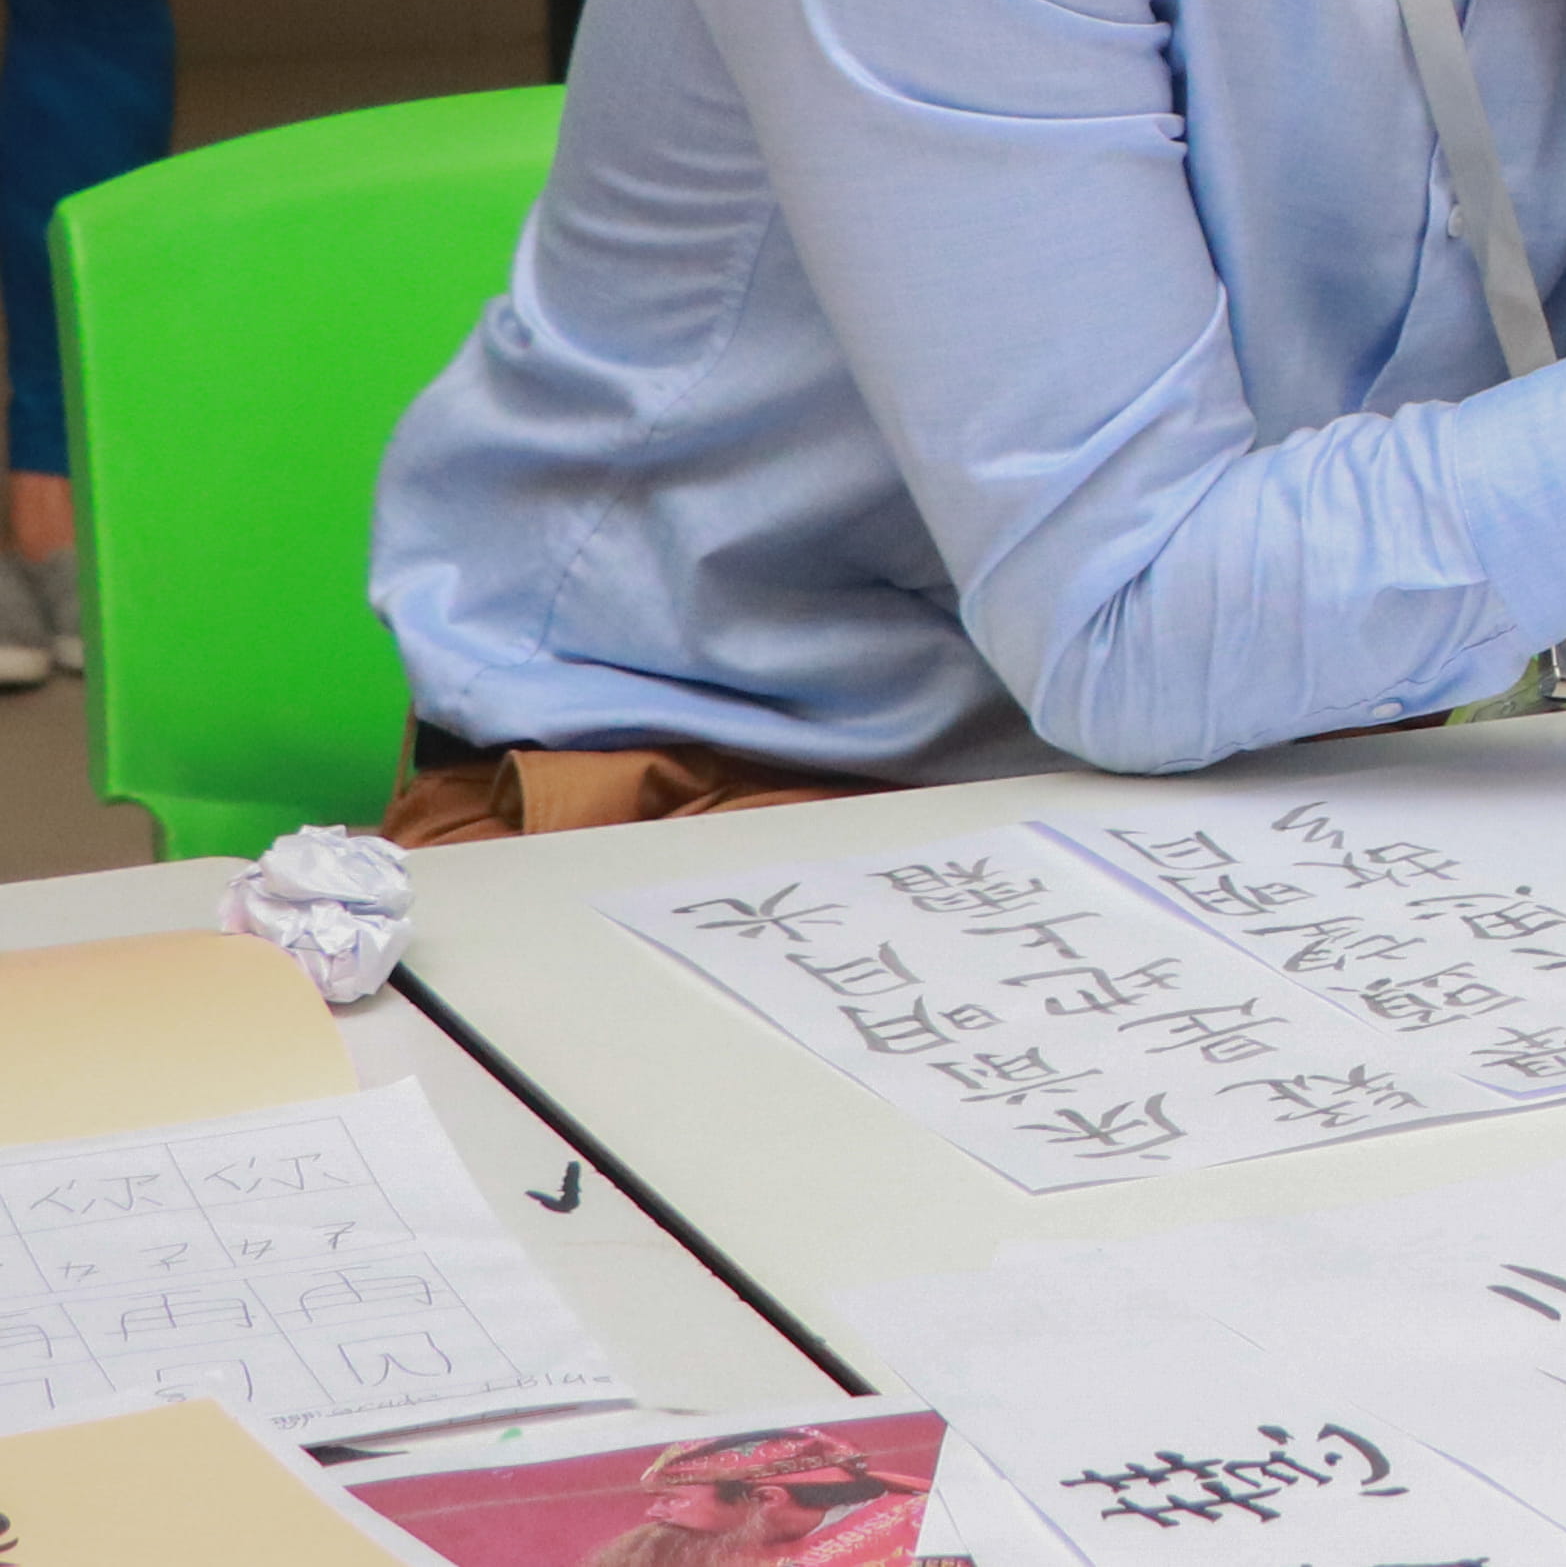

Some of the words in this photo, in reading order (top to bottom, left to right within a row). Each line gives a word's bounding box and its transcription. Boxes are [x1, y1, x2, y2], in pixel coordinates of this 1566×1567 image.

[671, 880, 1188, 1161] 床前明月光
